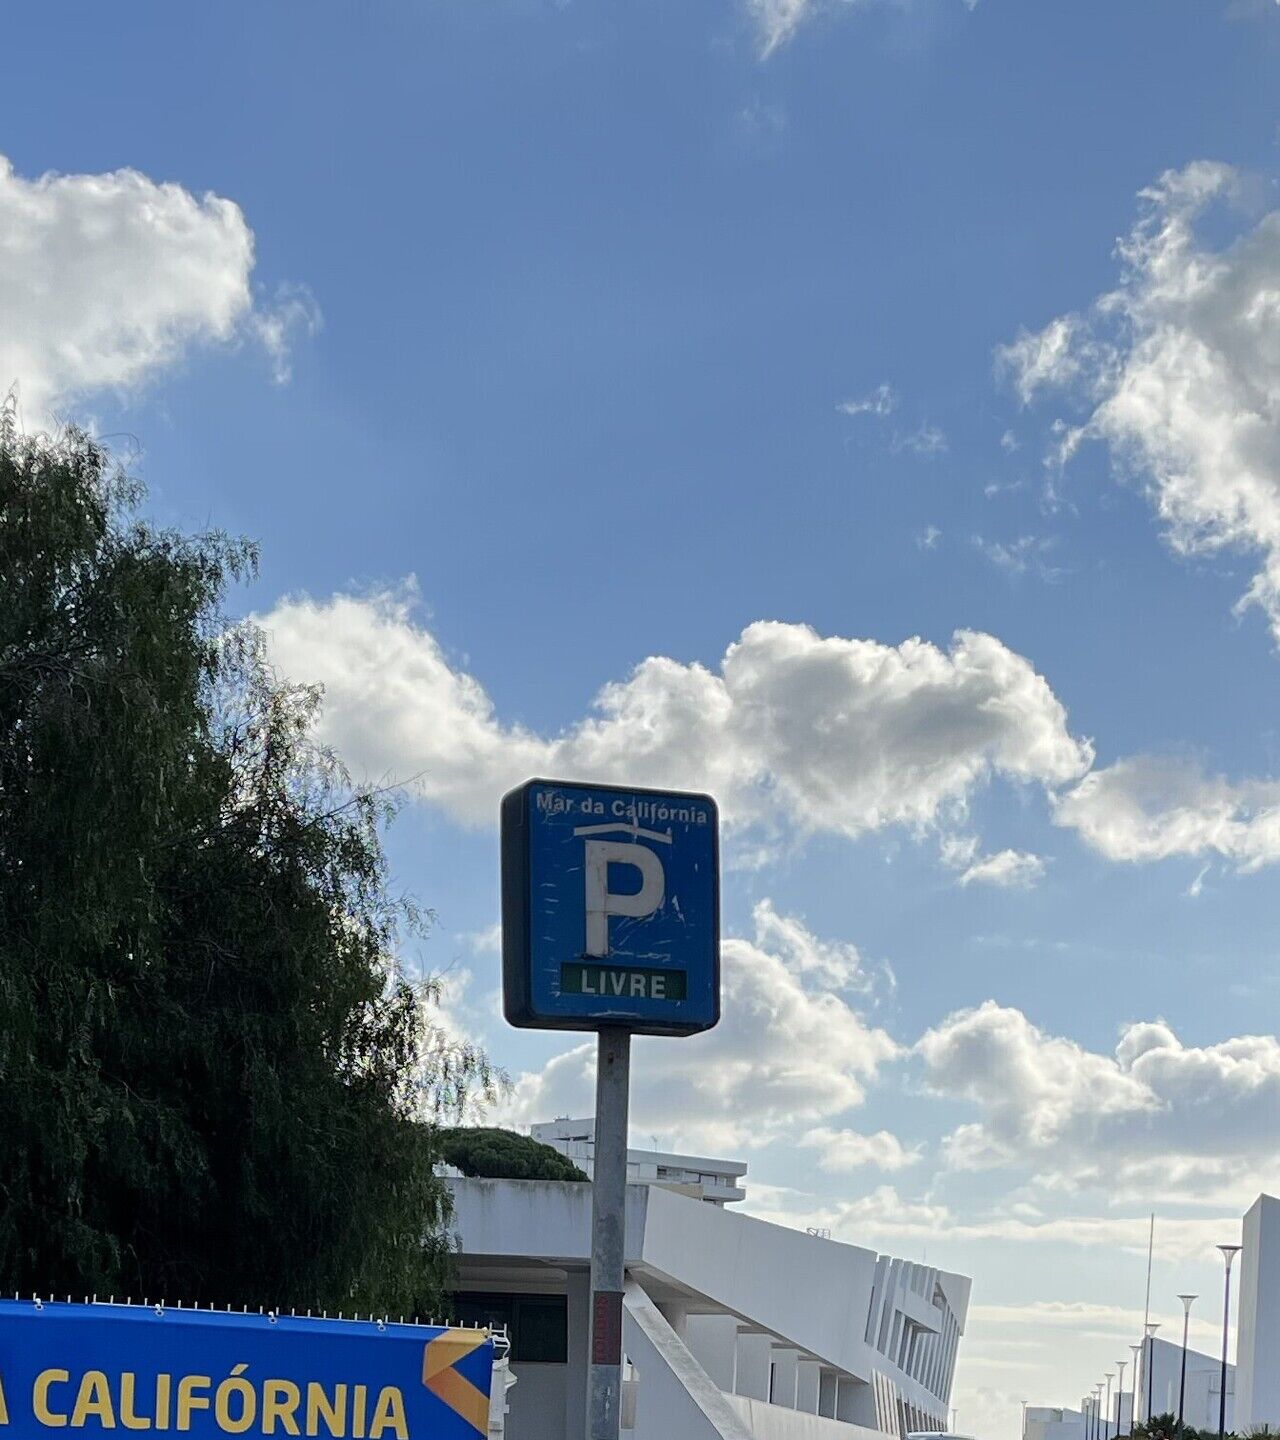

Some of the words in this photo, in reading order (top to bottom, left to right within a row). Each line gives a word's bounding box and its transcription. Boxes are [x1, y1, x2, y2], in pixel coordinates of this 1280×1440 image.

[536, 792, 574, 812] Mar
[581, 797, 605, 815] da
[611, 799, 708, 824] Califórnia
[584, 839, 666, 957] P
[581, 969, 666, 998] LIVRE
[32, 1363, 410, 1440] CALIFÓRNIA
